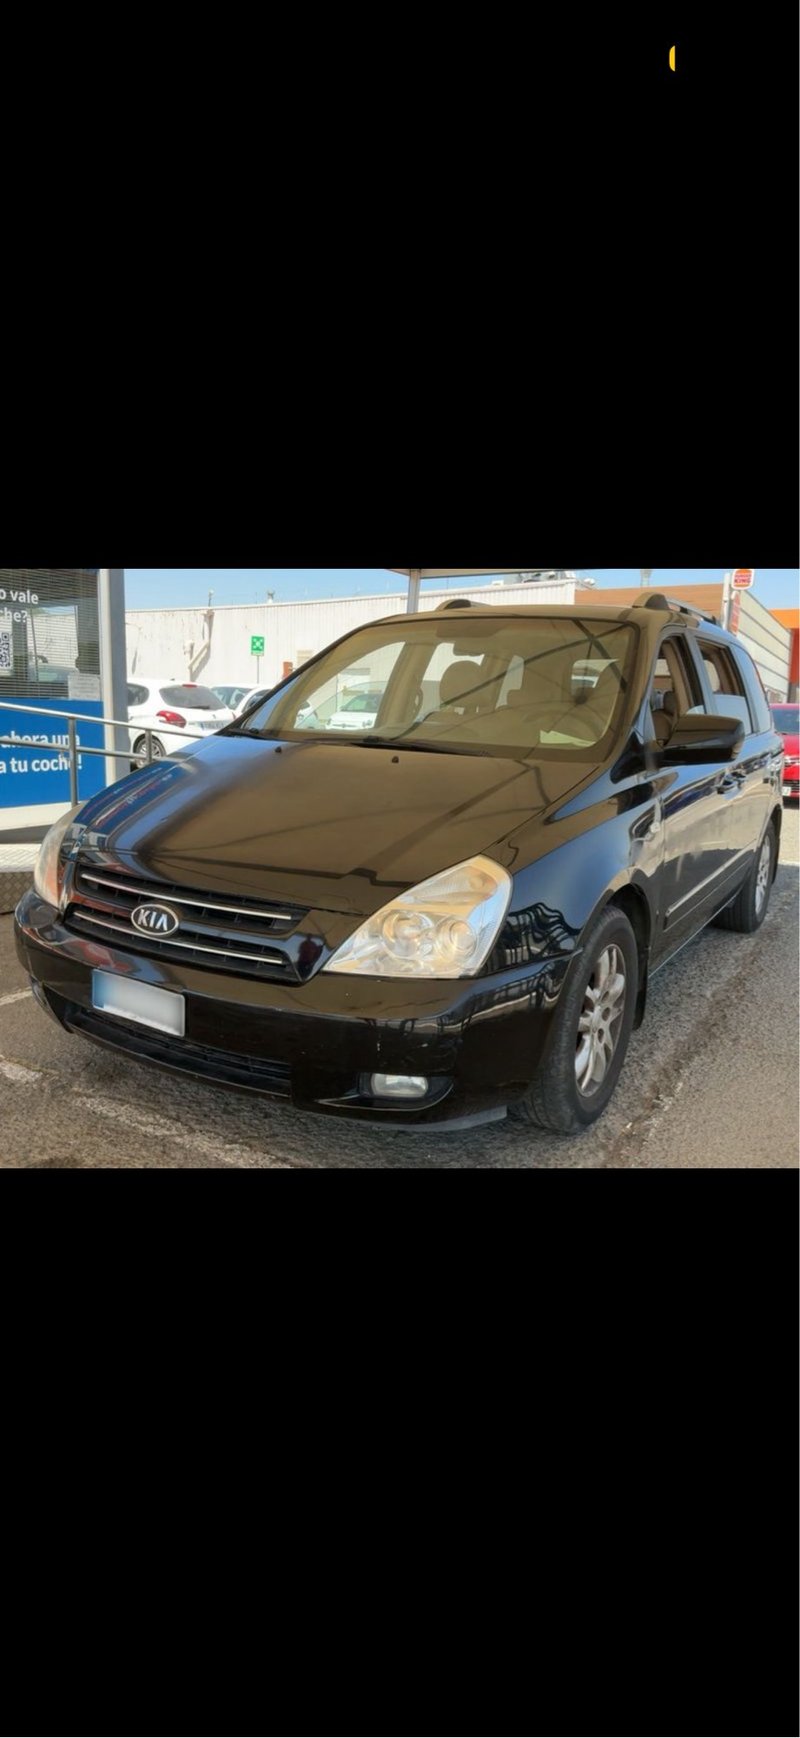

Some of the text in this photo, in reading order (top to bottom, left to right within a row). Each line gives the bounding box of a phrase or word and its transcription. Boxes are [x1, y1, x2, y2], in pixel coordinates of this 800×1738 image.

[10, 590, 39, 604] vale
[10, 758, 28, 773] tu
[32, 754, 82, 772] coch!
[137, 908, 168, 931] KIA
